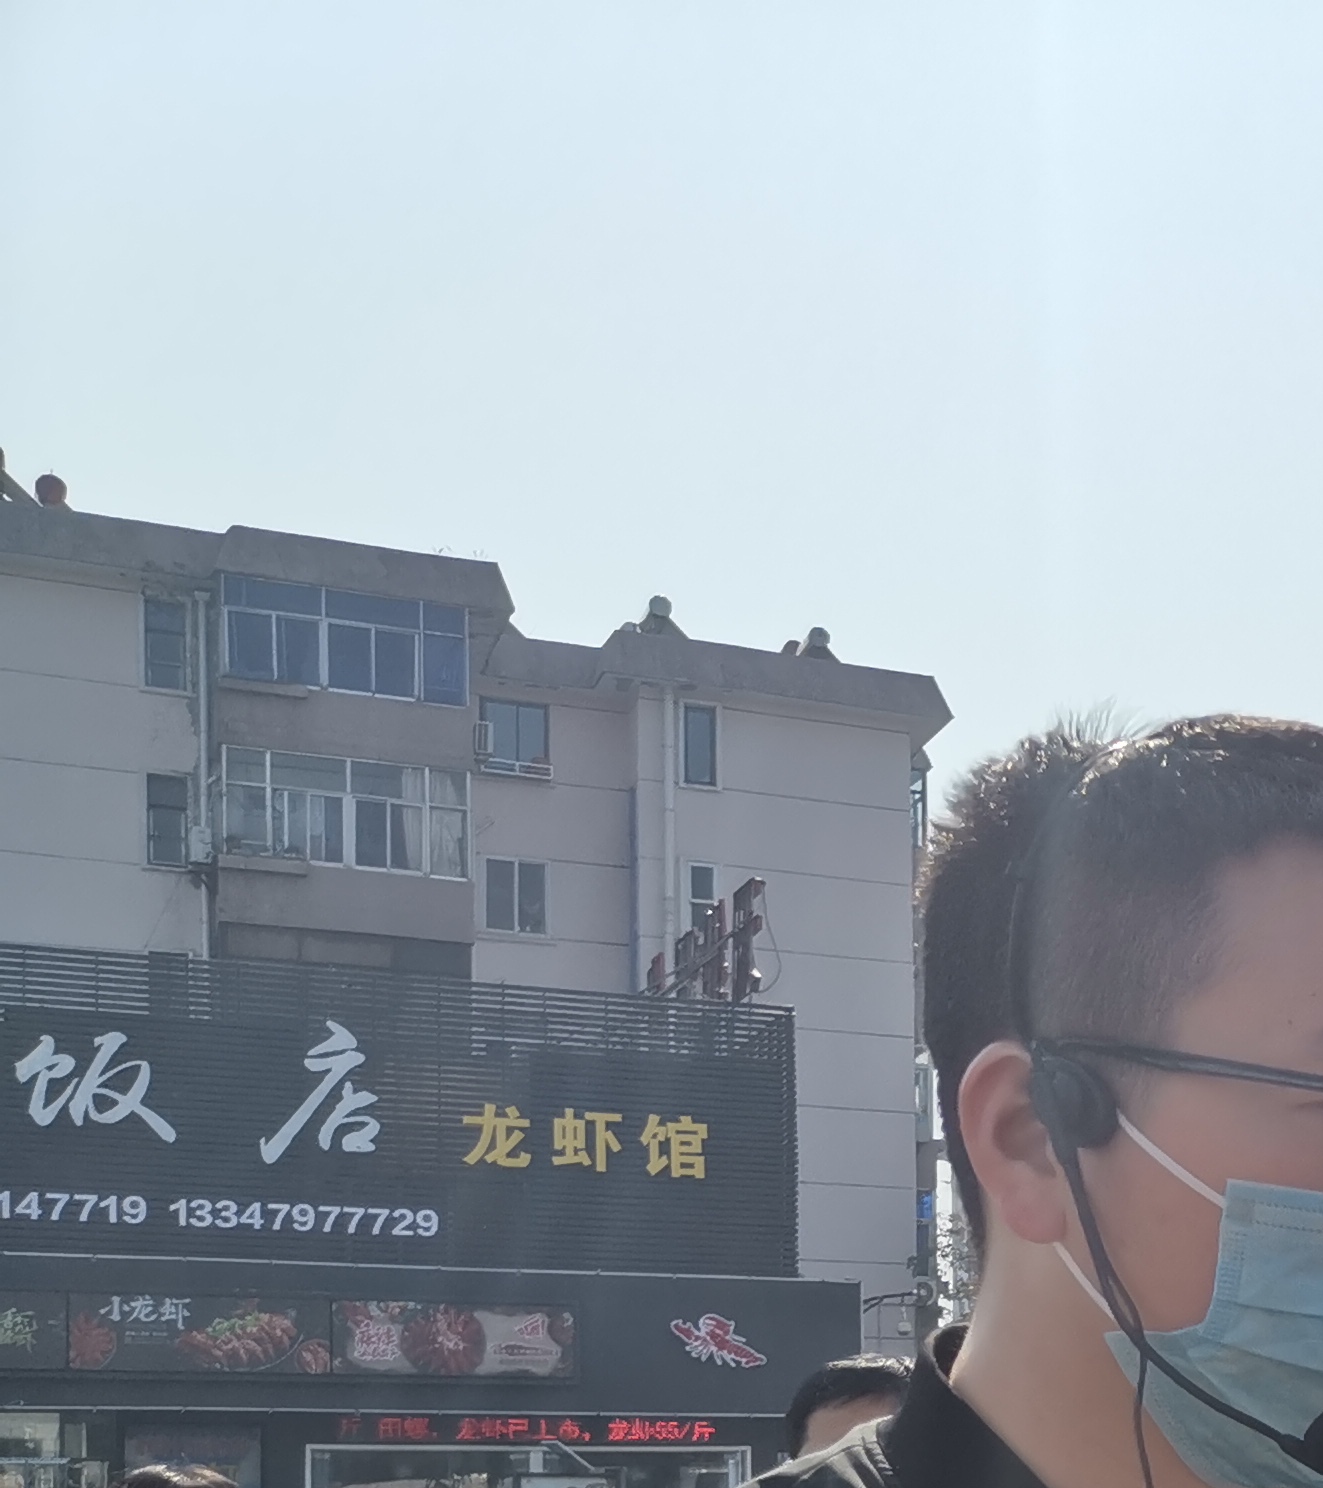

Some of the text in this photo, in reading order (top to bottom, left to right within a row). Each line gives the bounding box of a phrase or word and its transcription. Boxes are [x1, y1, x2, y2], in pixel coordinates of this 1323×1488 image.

[461, 1104, 709, 1179] 龙虾馆
[168, 1198, 440, 1237] 13347977729
[99, 1295, 192, 1330] 小龙虾
